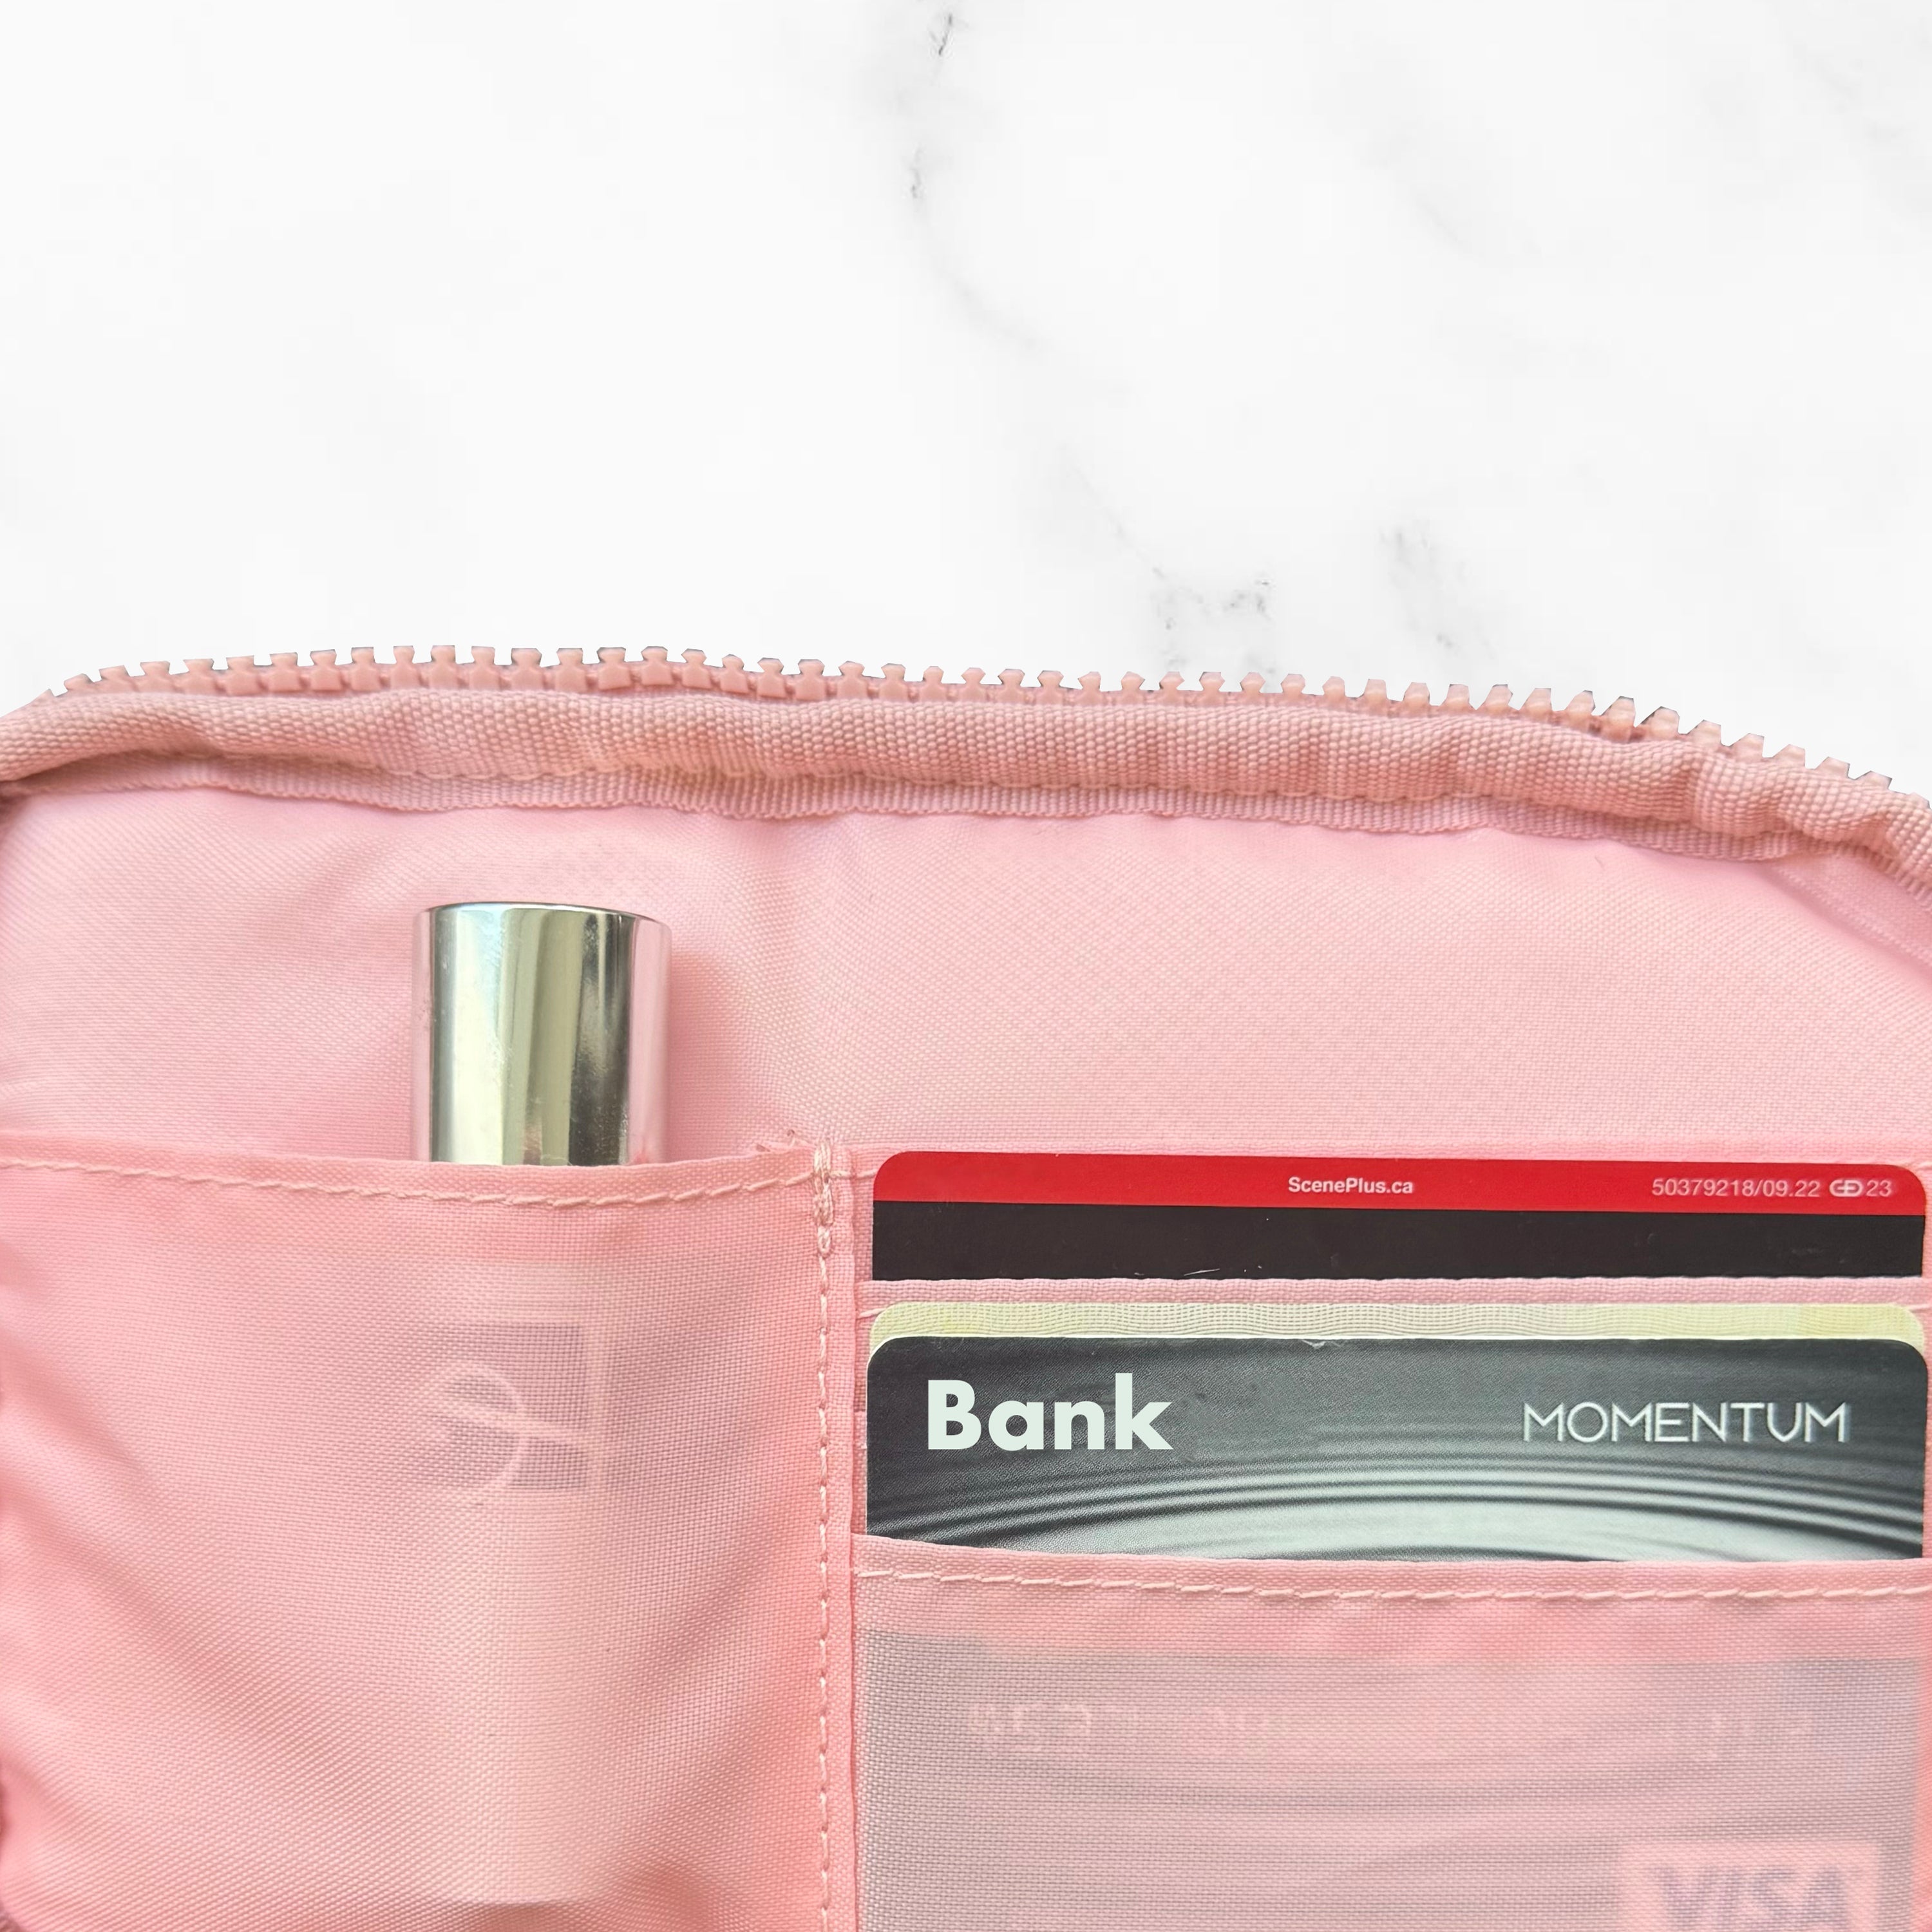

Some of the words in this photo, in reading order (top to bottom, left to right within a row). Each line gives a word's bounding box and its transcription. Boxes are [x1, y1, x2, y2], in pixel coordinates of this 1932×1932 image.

[1288, 1176, 1413, 1193] ScenePlus.ca
[1652, 1179, 1821, 1197] 50379218/09.22
[1866, 1179, 1892, 1197] 23
[928, 1373, 1174, 1451] Bank
[1524, 1402, 1848, 1443] MOMENTUM
[1647, 1864, 1857, 1932] VISA
